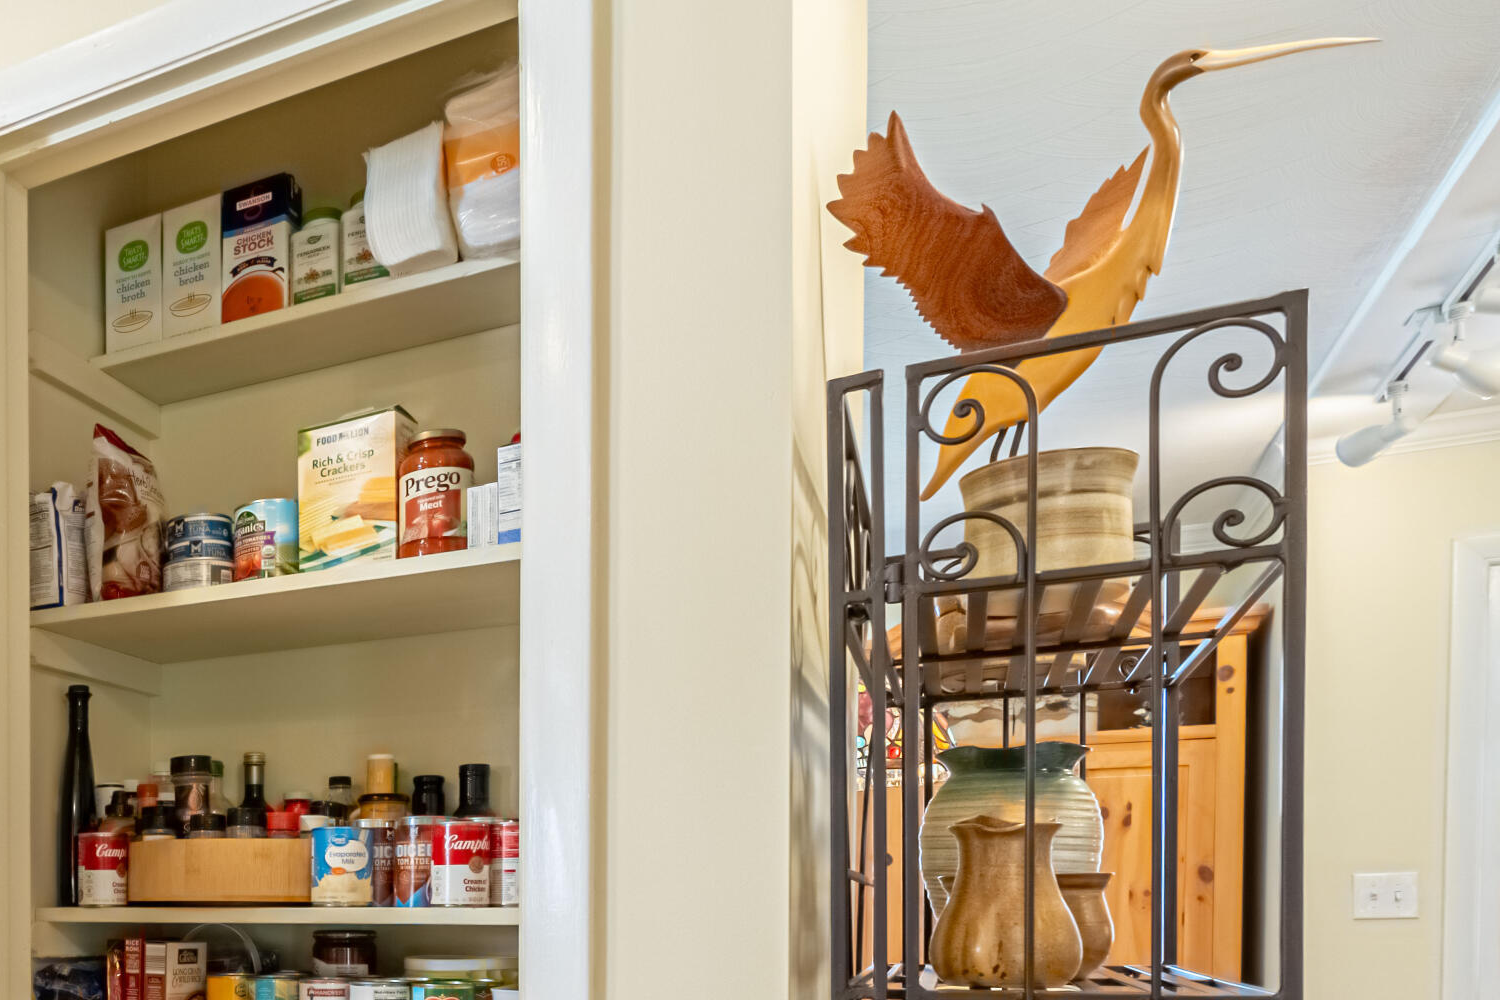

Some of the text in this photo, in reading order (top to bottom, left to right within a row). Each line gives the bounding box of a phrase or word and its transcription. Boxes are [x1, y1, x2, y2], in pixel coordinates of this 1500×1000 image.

[238, 194, 271, 210] SWANSON
[237, 230, 272, 246] CHICKEN
[234, 237, 274, 256] STOCK
[174, 262, 209, 277] chicken
[117, 279, 150, 294] chicken
[179, 273, 204, 286] broth
[122, 290, 145, 303] broth
[317, 435, 337, 446] FOOD
[312, 449, 374, 469] Rich & Crisp
[320, 462, 366, 478] Crackers
[405, 472, 460, 497] Prego
[420, 500, 442, 511] Meat
[188, 525, 210, 533] TUNA
[329, 851, 366, 859] Evaporated
